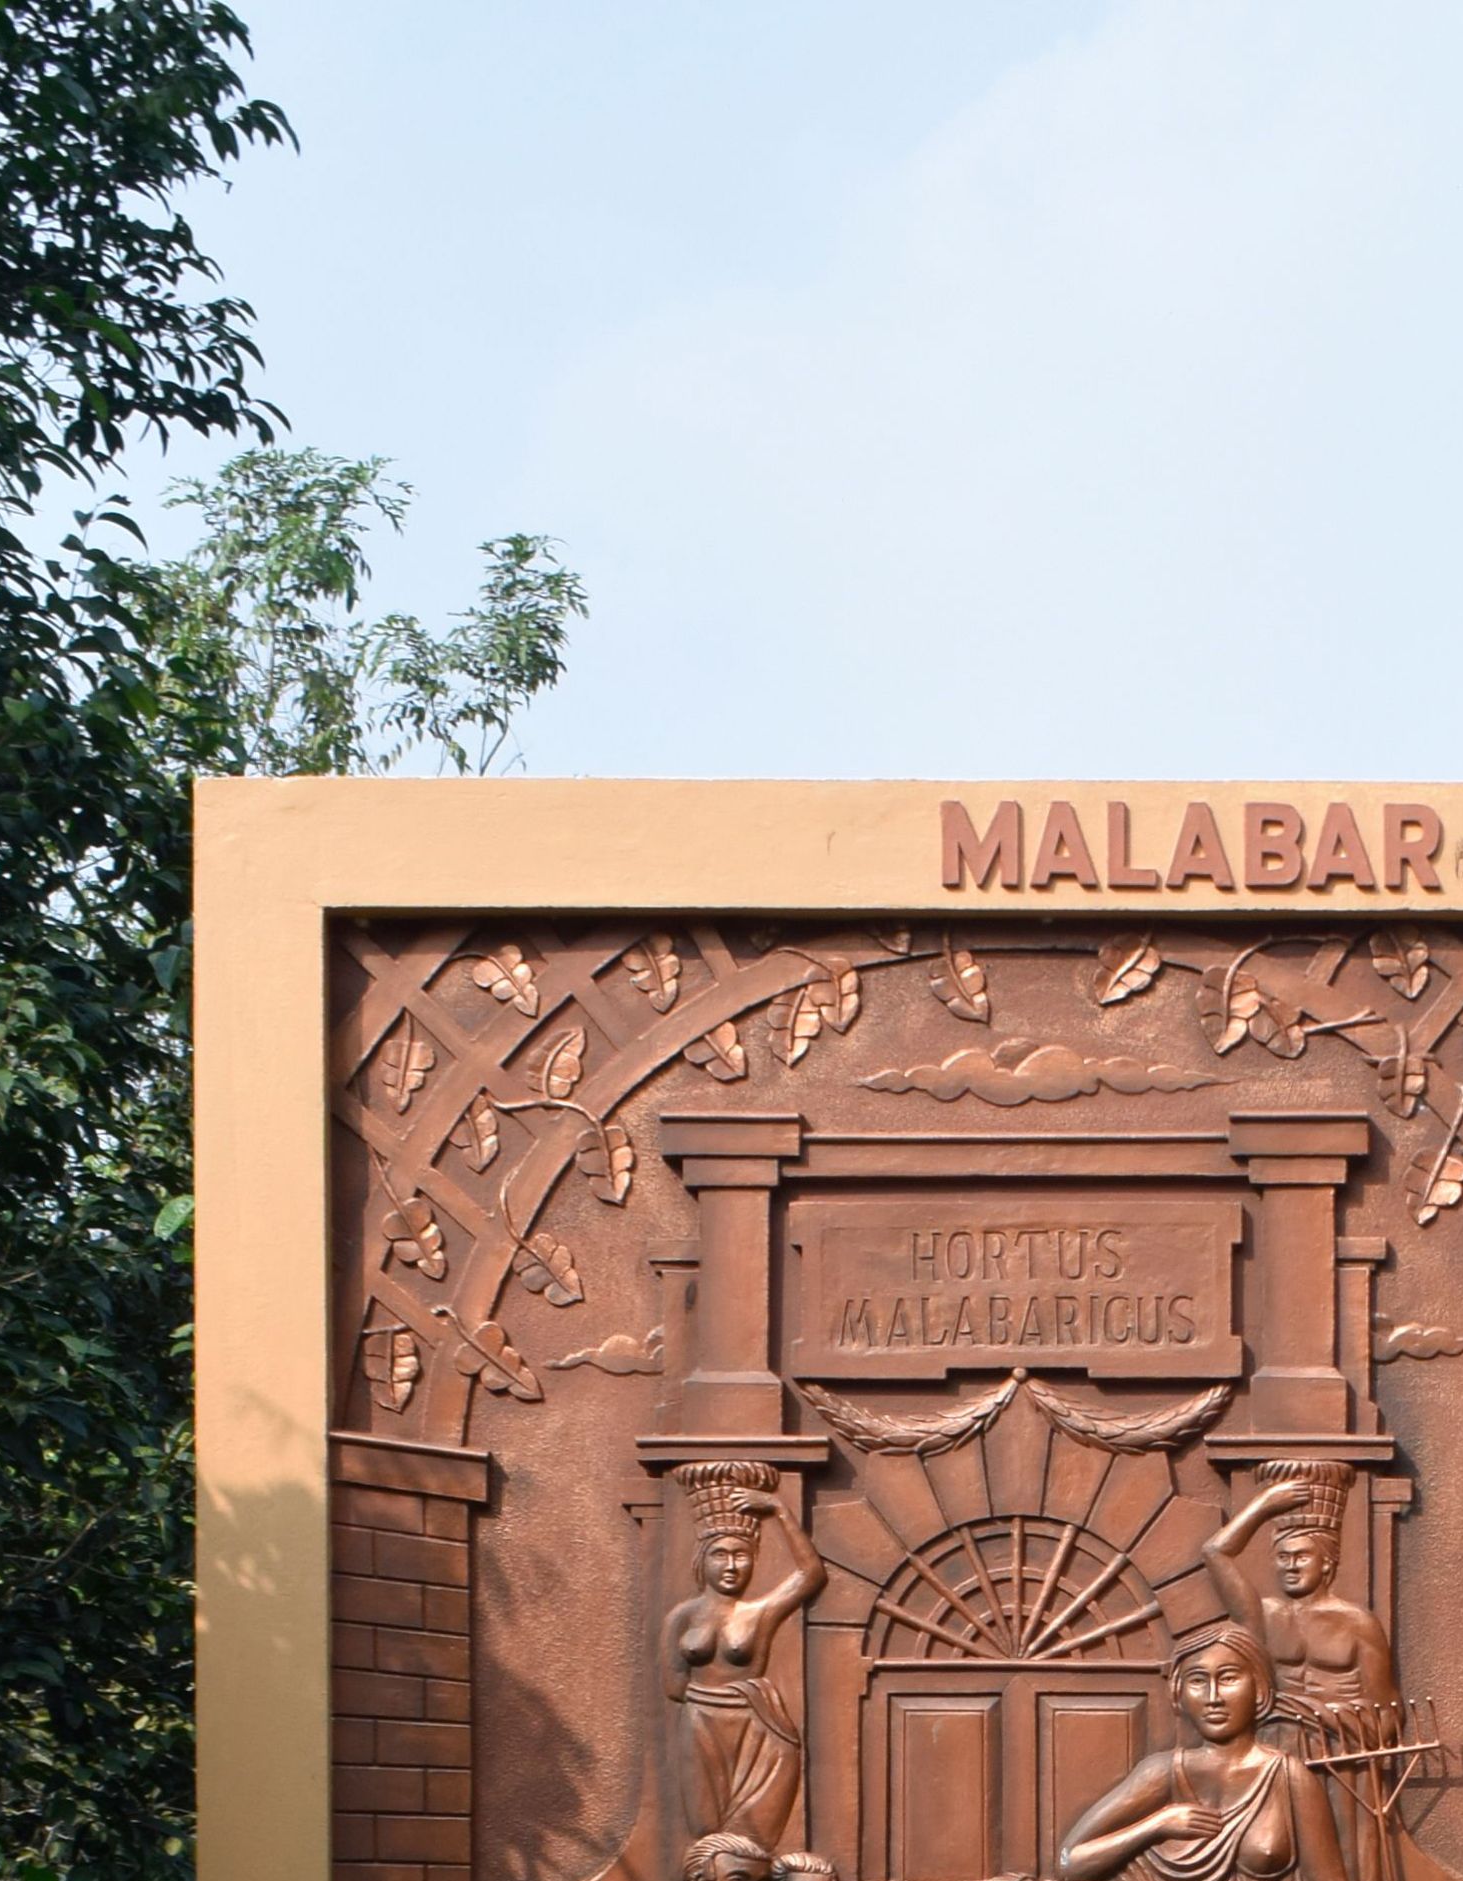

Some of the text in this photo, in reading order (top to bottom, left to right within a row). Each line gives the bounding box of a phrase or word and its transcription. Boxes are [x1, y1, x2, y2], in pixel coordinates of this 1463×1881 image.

[939, 800, 1444, 893] MALABAR
[910, 1228, 1127, 1283] HORTUS
[838, 1294, 1198, 1349] MALABARICUS
